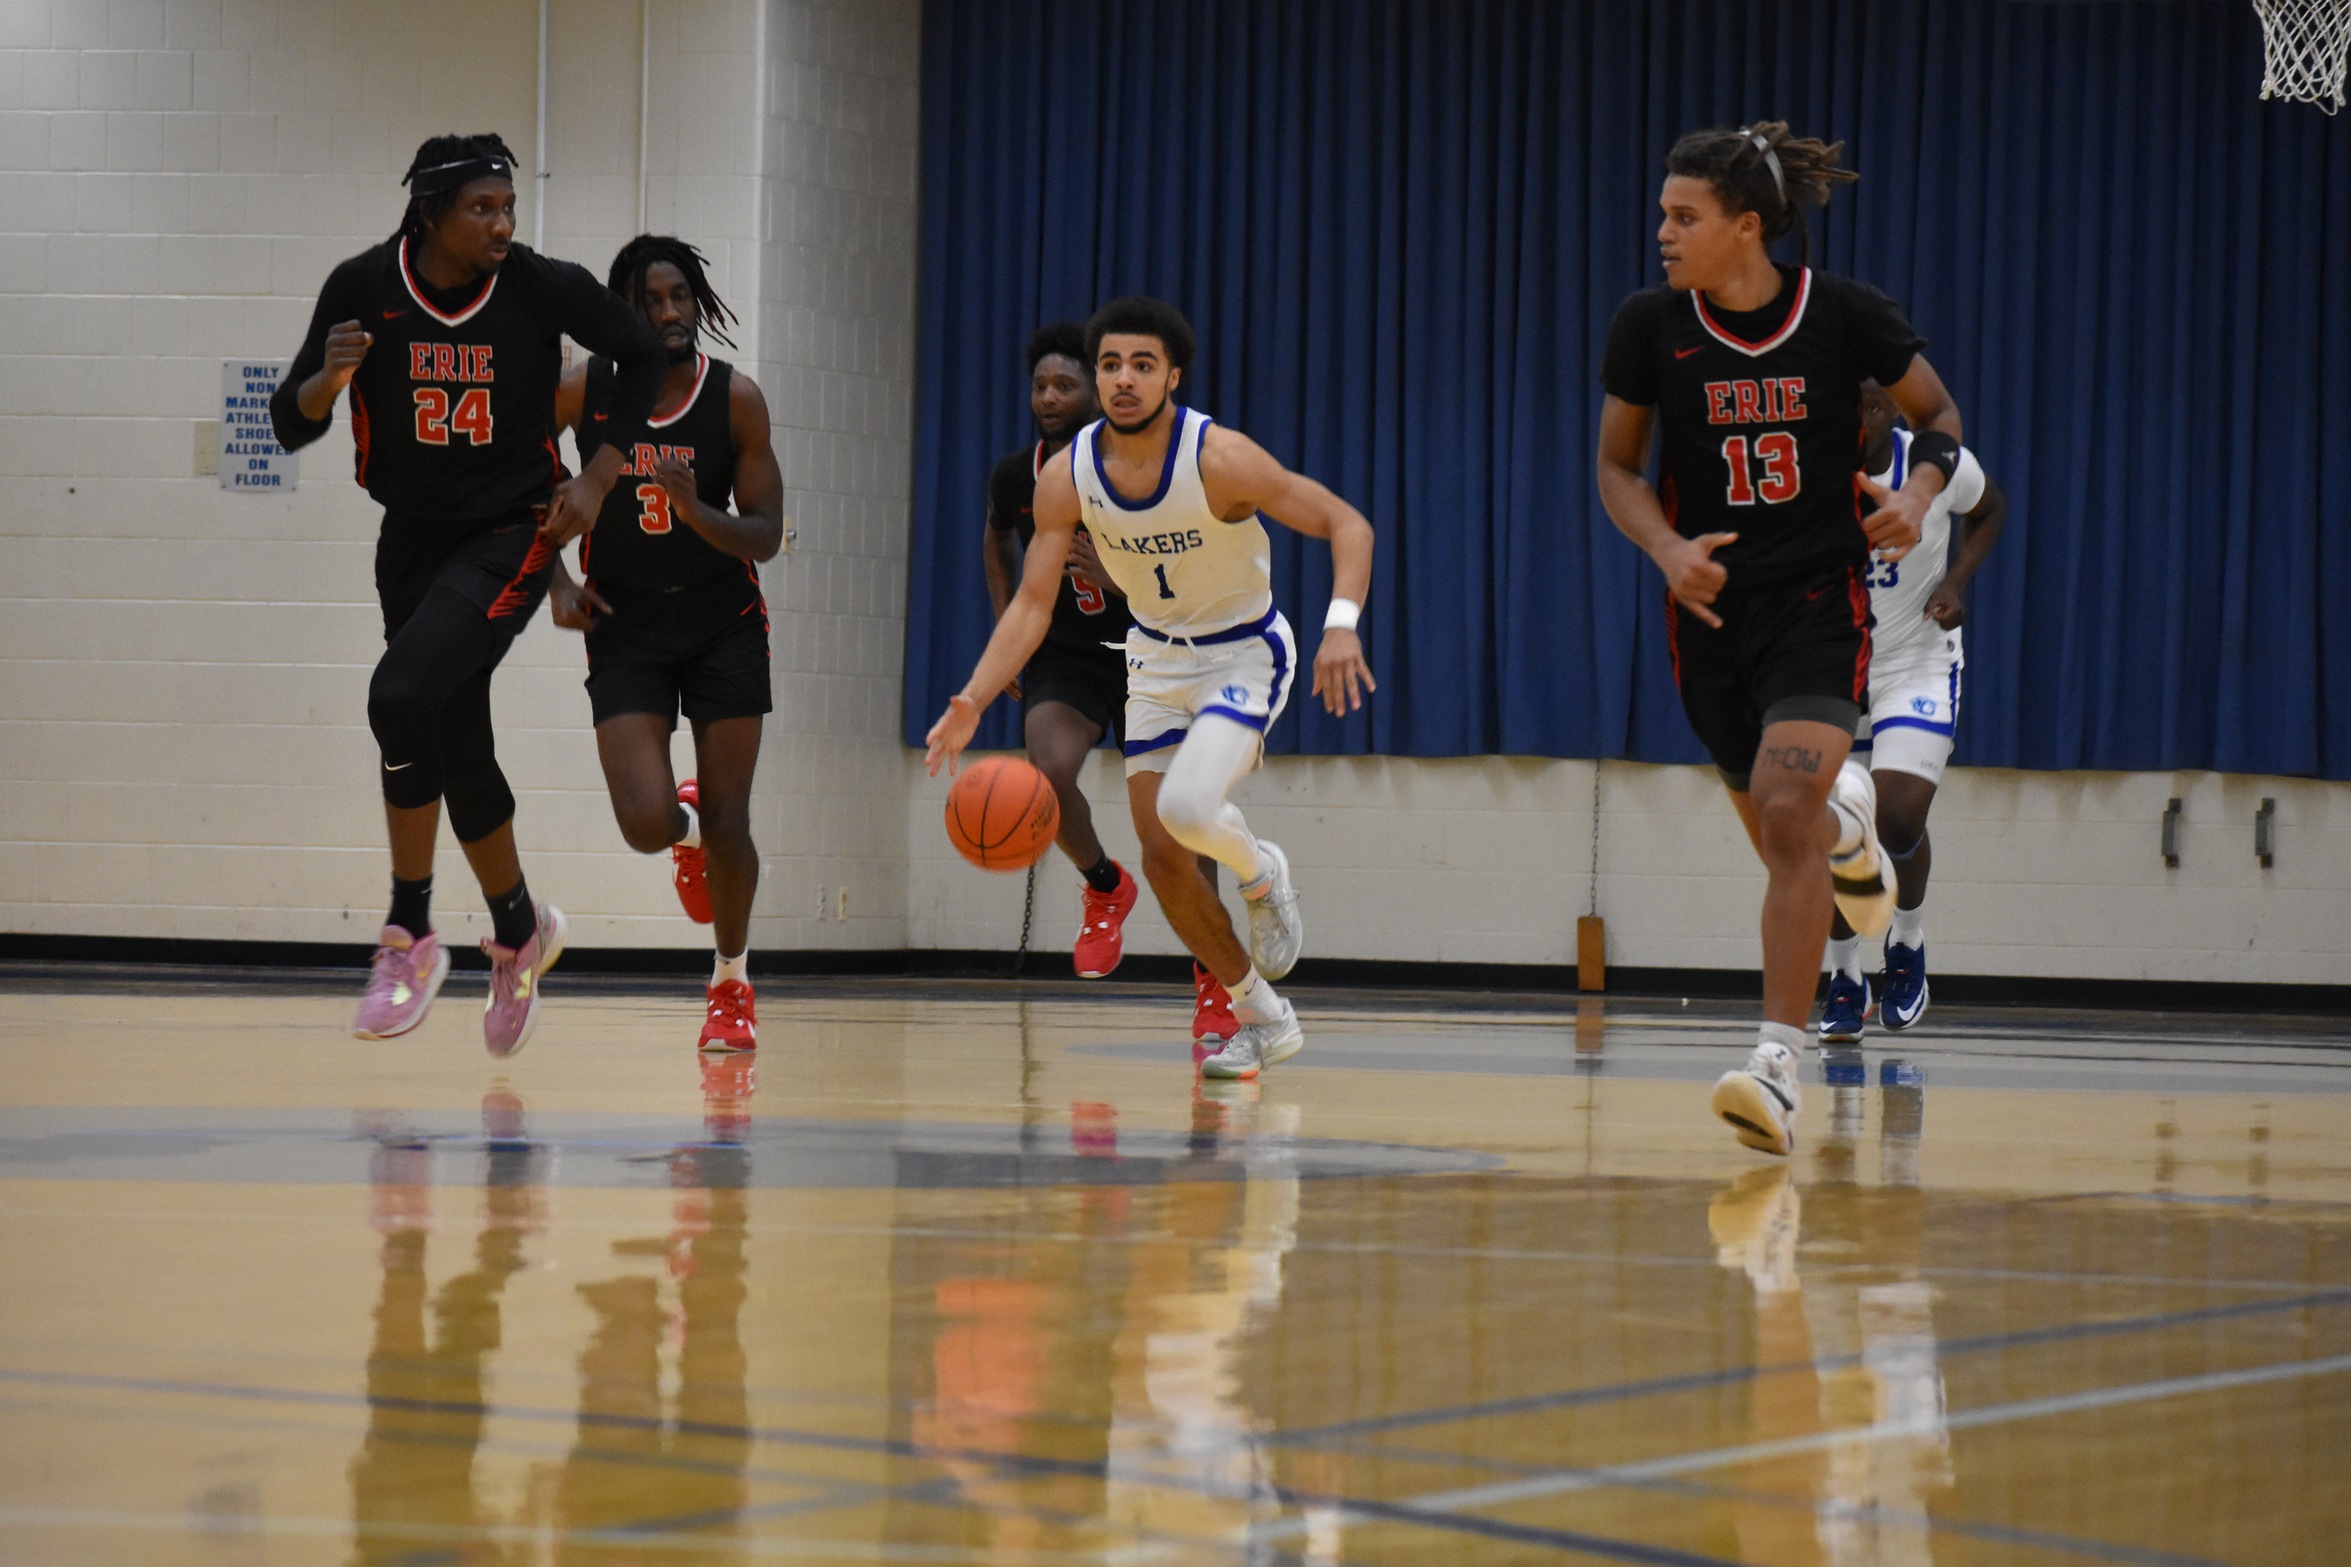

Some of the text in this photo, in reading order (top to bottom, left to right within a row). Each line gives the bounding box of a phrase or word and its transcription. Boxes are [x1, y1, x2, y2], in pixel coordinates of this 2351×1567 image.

[243, 366, 279, 378] ONLY
[410, 342, 494, 382] ERIE
[246, 382, 277, 394] NON
[1704, 377, 1807, 424] ERIE
[226, 397, 269, 409] MARK
[226, 412, 271, 424] ATHLE
[413, 388, 493, 446] 24
[235, 427, 275, 440] SHOE
[248, 458, 268, 470] ON
[1721, 431, 1801, 505] 13
[235, 474, 281, 486] FLOOR
[636, 482, 673, 535] 3
[1101, 529, 1204, 555] LAKERS
[1069, 565, 1107, 616] 5
[1154, 563, 1176, 600] 1
